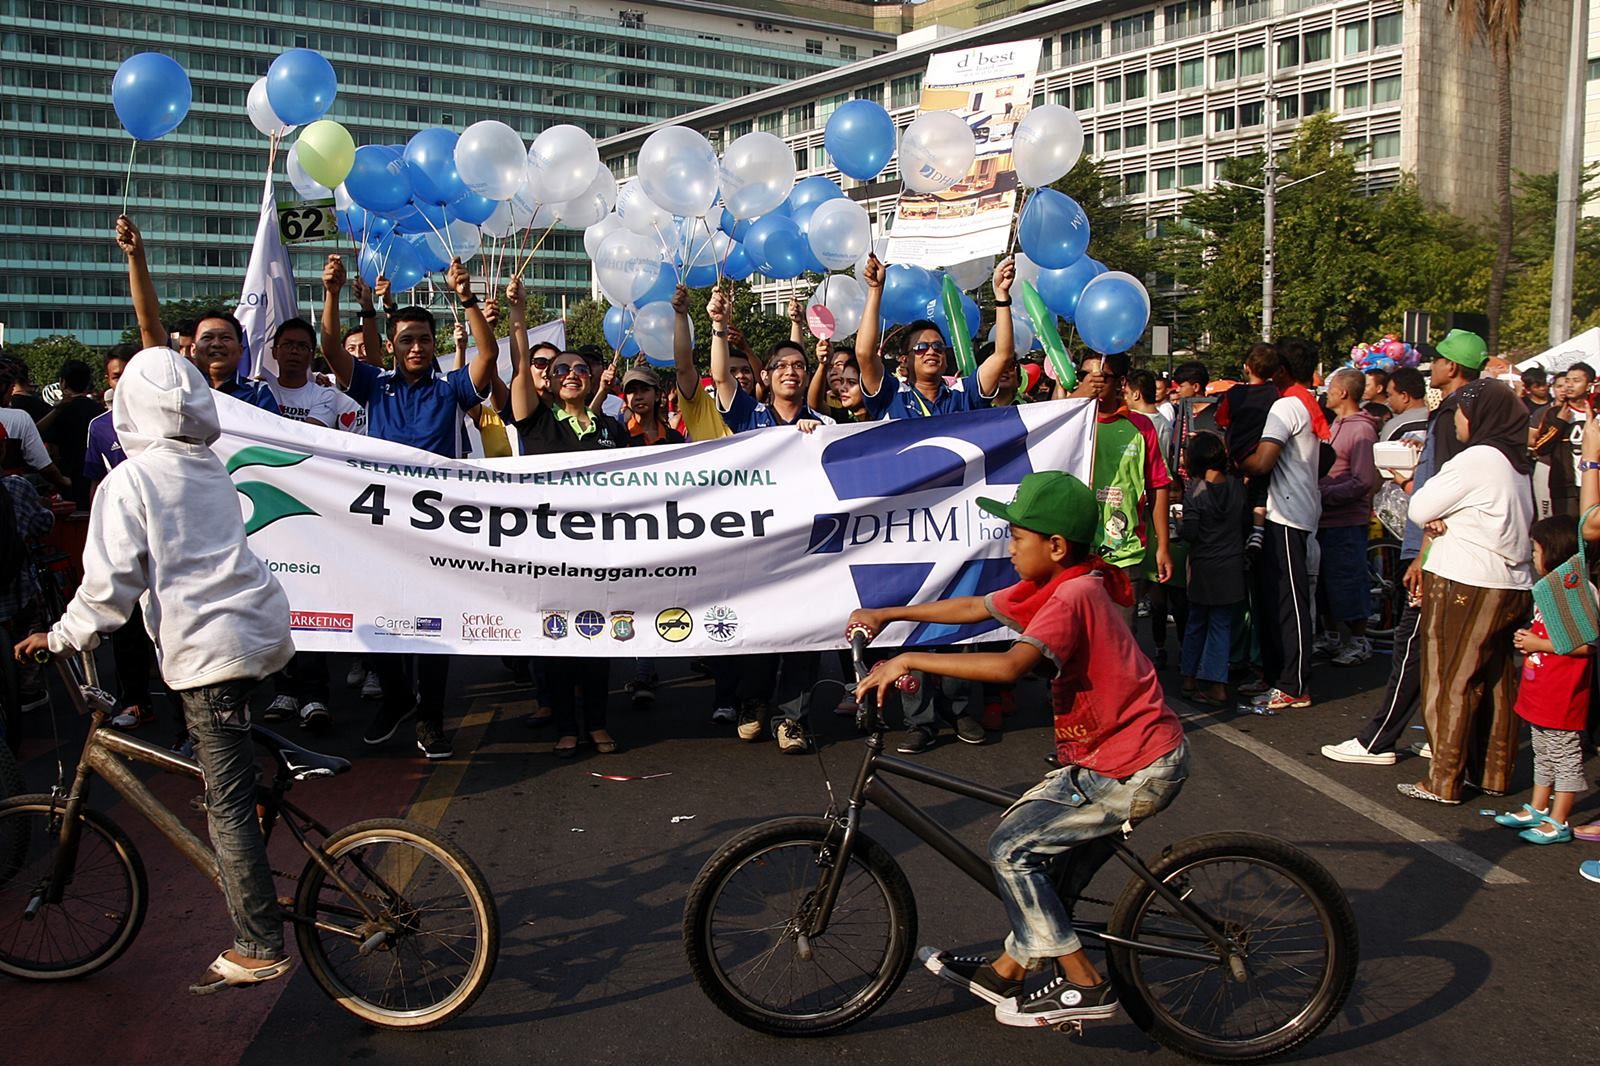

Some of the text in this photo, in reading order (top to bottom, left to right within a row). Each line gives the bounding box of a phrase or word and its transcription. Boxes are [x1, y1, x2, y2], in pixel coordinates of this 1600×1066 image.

[280, 207, 325, 240] 62
[346, 459, 777, 486] SELAMAT HARI PELANGGAN NASIONAL
[349, 483, 774, 547] 4 September
[849, 506, 960, 546] DHM
[265, 559, 320, 575] onesia
[429, 556, 697, 581] www.haripelanggan.com
[462, 612, 503, 626] Service
[462, 626, 521, 639] Excellence
